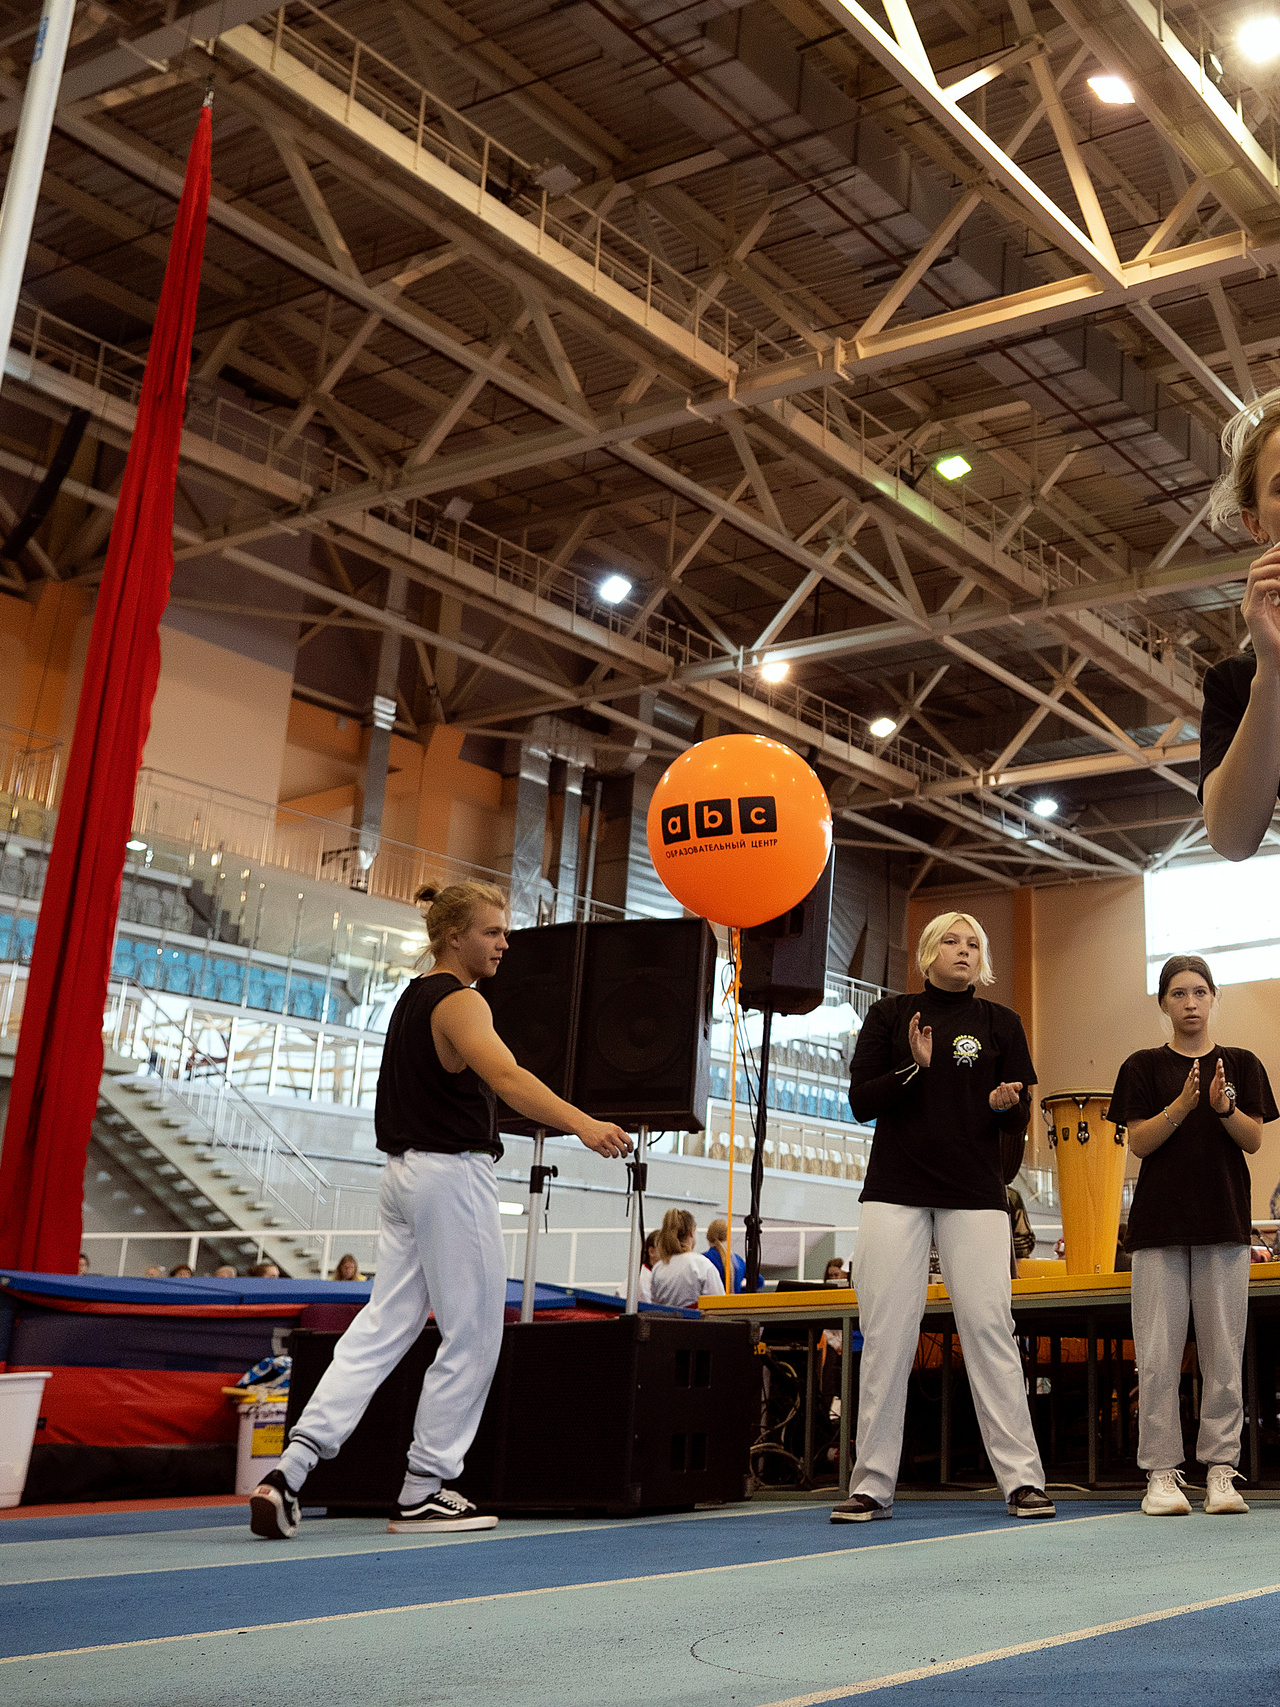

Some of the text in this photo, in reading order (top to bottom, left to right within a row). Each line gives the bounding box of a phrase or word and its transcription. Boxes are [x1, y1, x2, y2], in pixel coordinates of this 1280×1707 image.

[666, 804, 768, 836] abc
[665, 838, 778, 859] ОБРАЗОВАТЕЛЬНЫЙ ЦЕНТР
